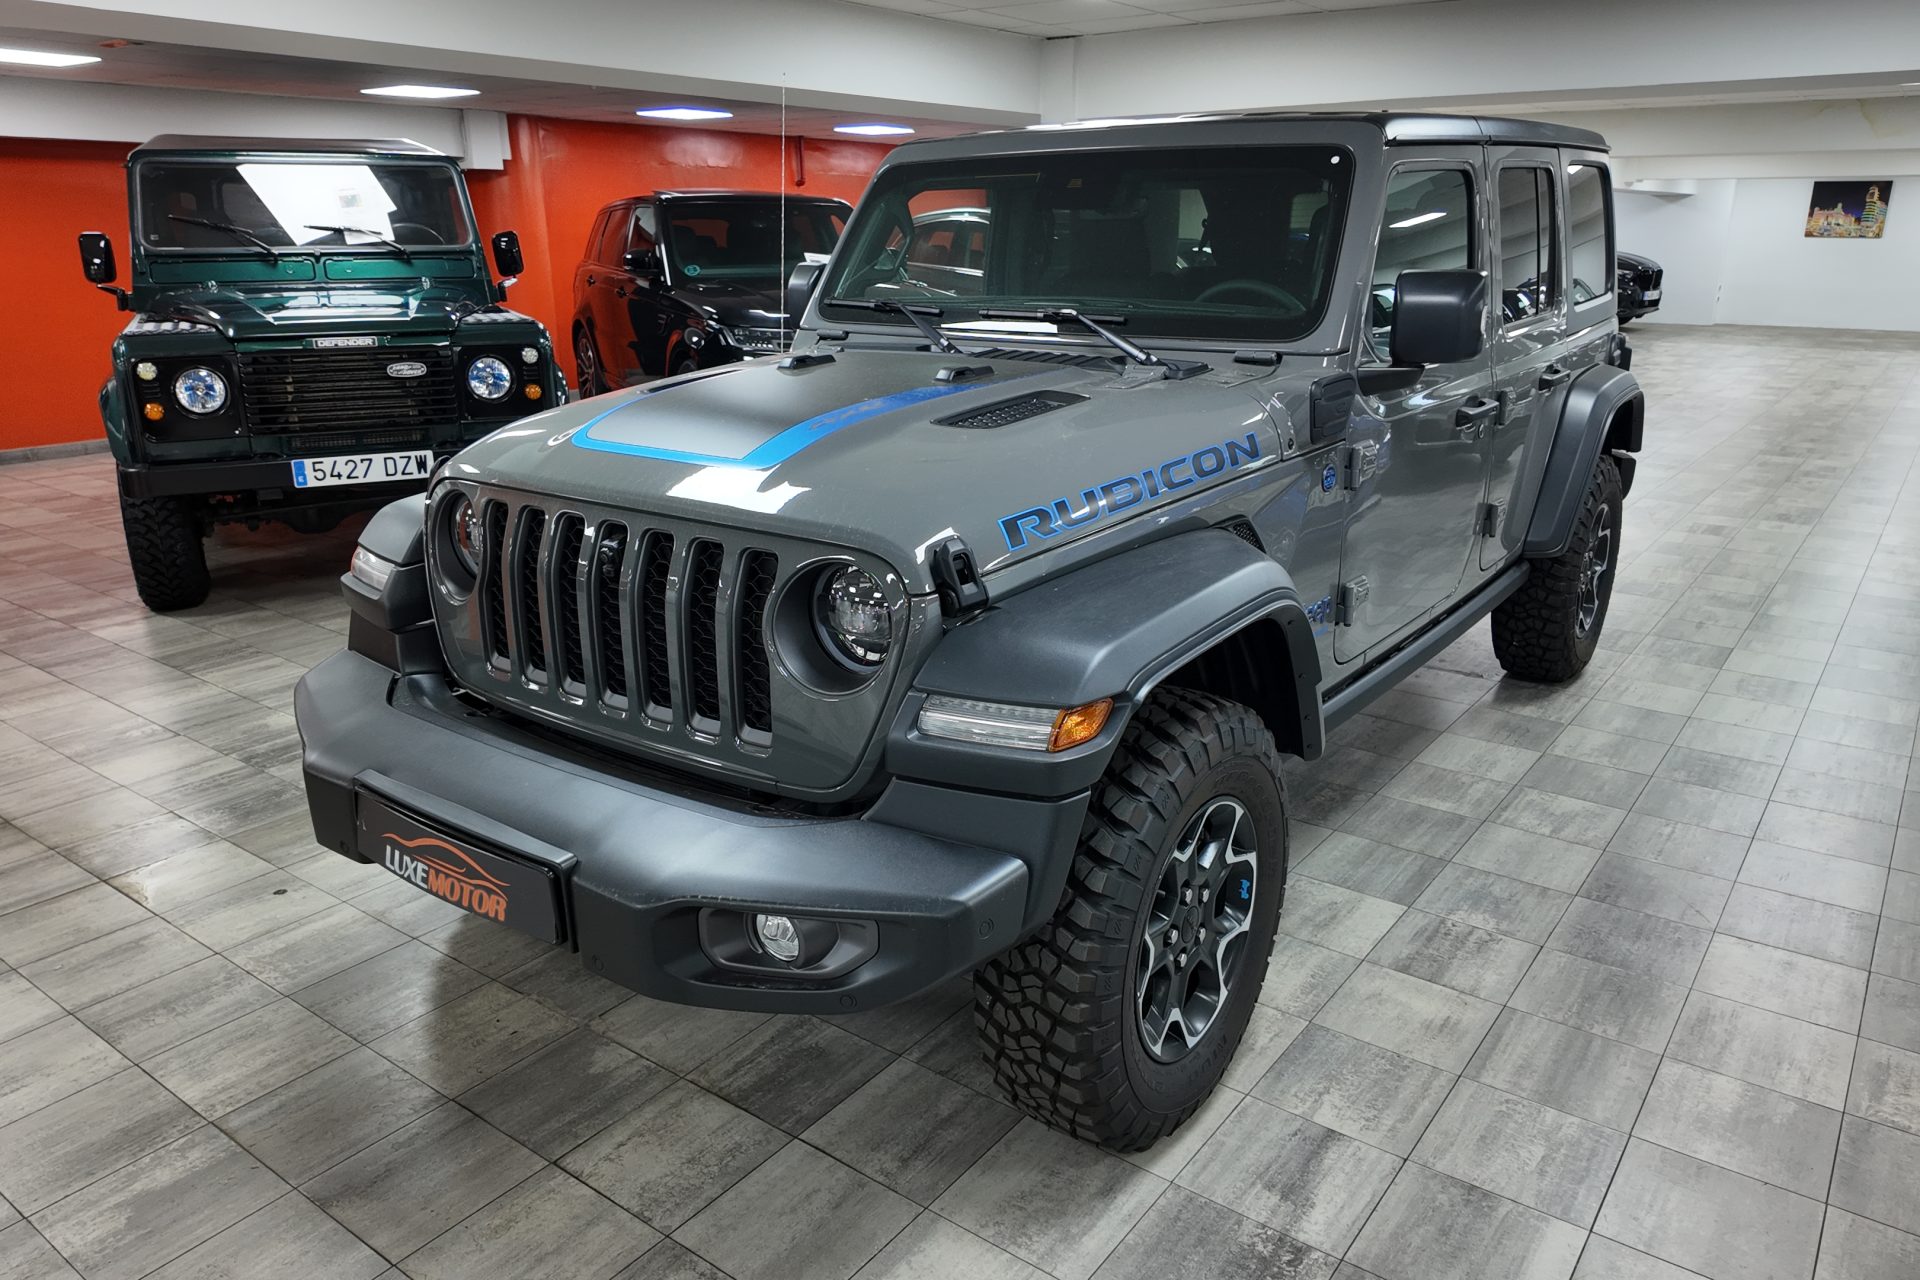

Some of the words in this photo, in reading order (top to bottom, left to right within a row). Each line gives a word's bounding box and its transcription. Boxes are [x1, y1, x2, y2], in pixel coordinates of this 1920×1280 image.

[317, 338, 374, 347] DEFENDER
[311, 457, 373, 482] 5427
[384, 454, 428, 477] DZW
[998, 432, 1260, 551] RUBICON
[385, 844, 508, 922] LUXEMOTOR
